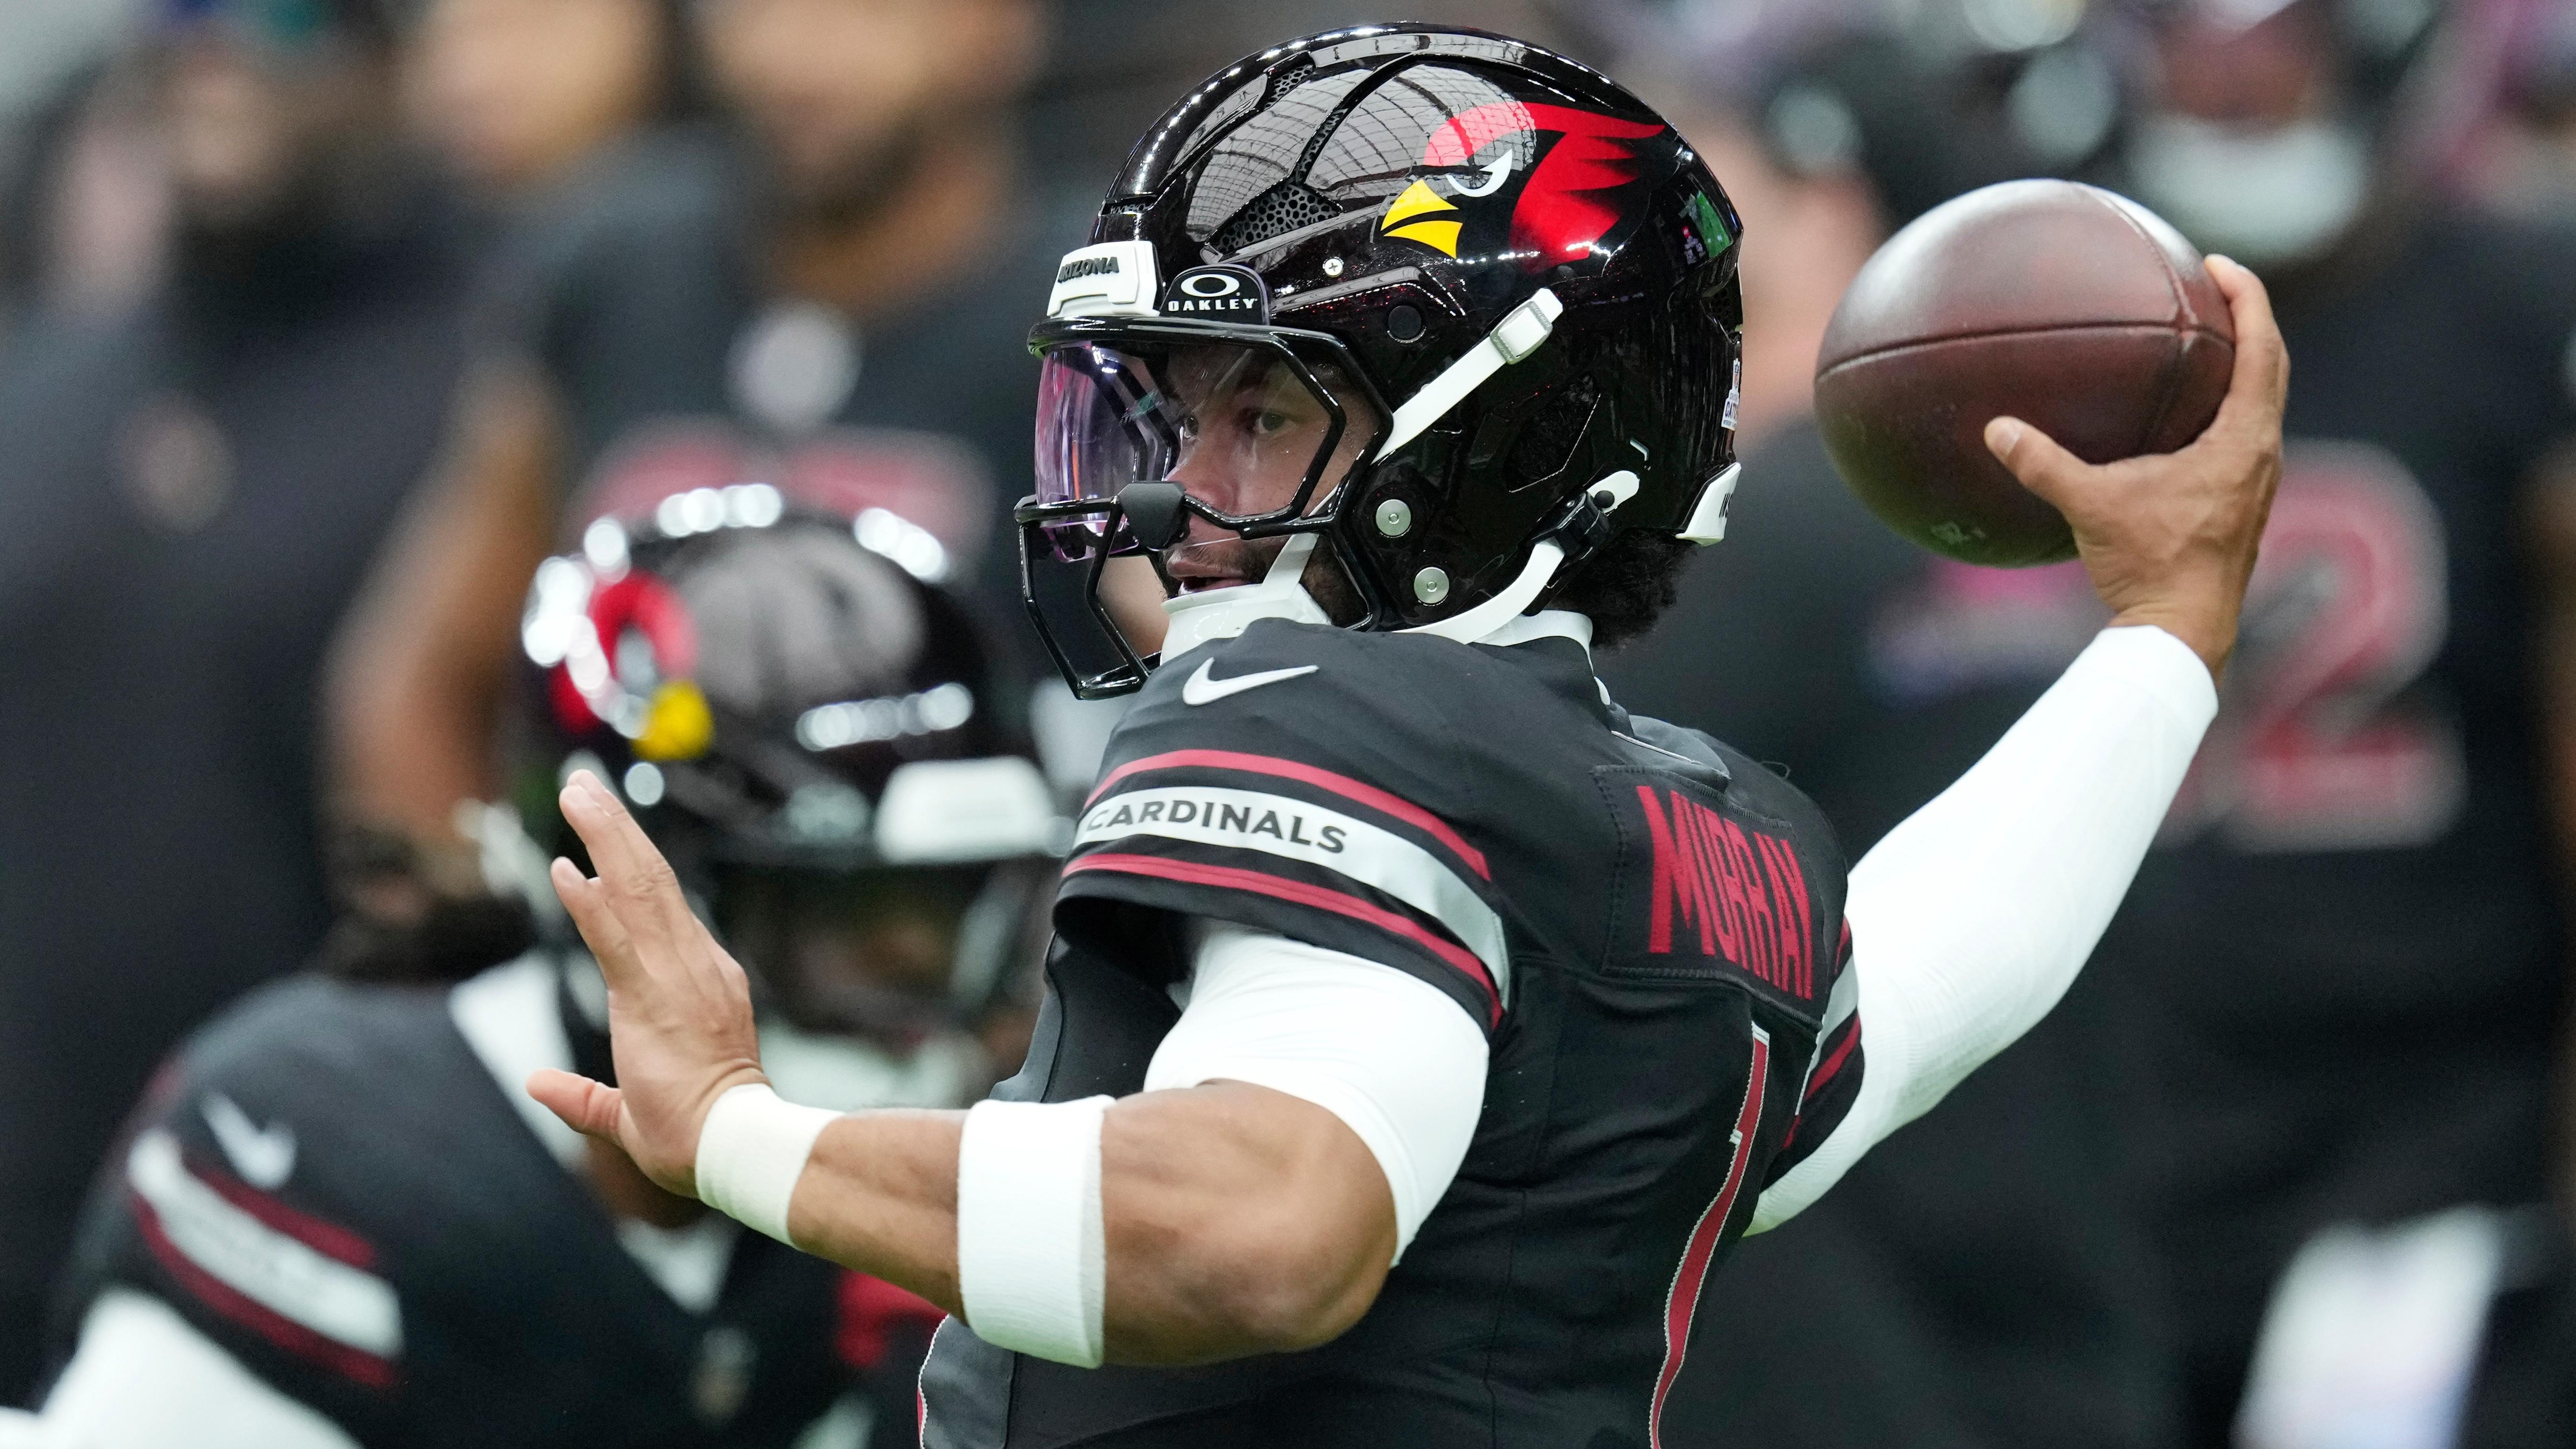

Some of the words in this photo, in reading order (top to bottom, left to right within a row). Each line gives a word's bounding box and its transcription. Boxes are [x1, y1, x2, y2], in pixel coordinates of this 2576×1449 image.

[1058, 257, 1120, 283] ARIZONA
[1168, 298, 1255, 312] OAKLEY
[1086, 799, 1347, 854] CARDINALS
[1635, 786, 1812, 1000] MURRAY
